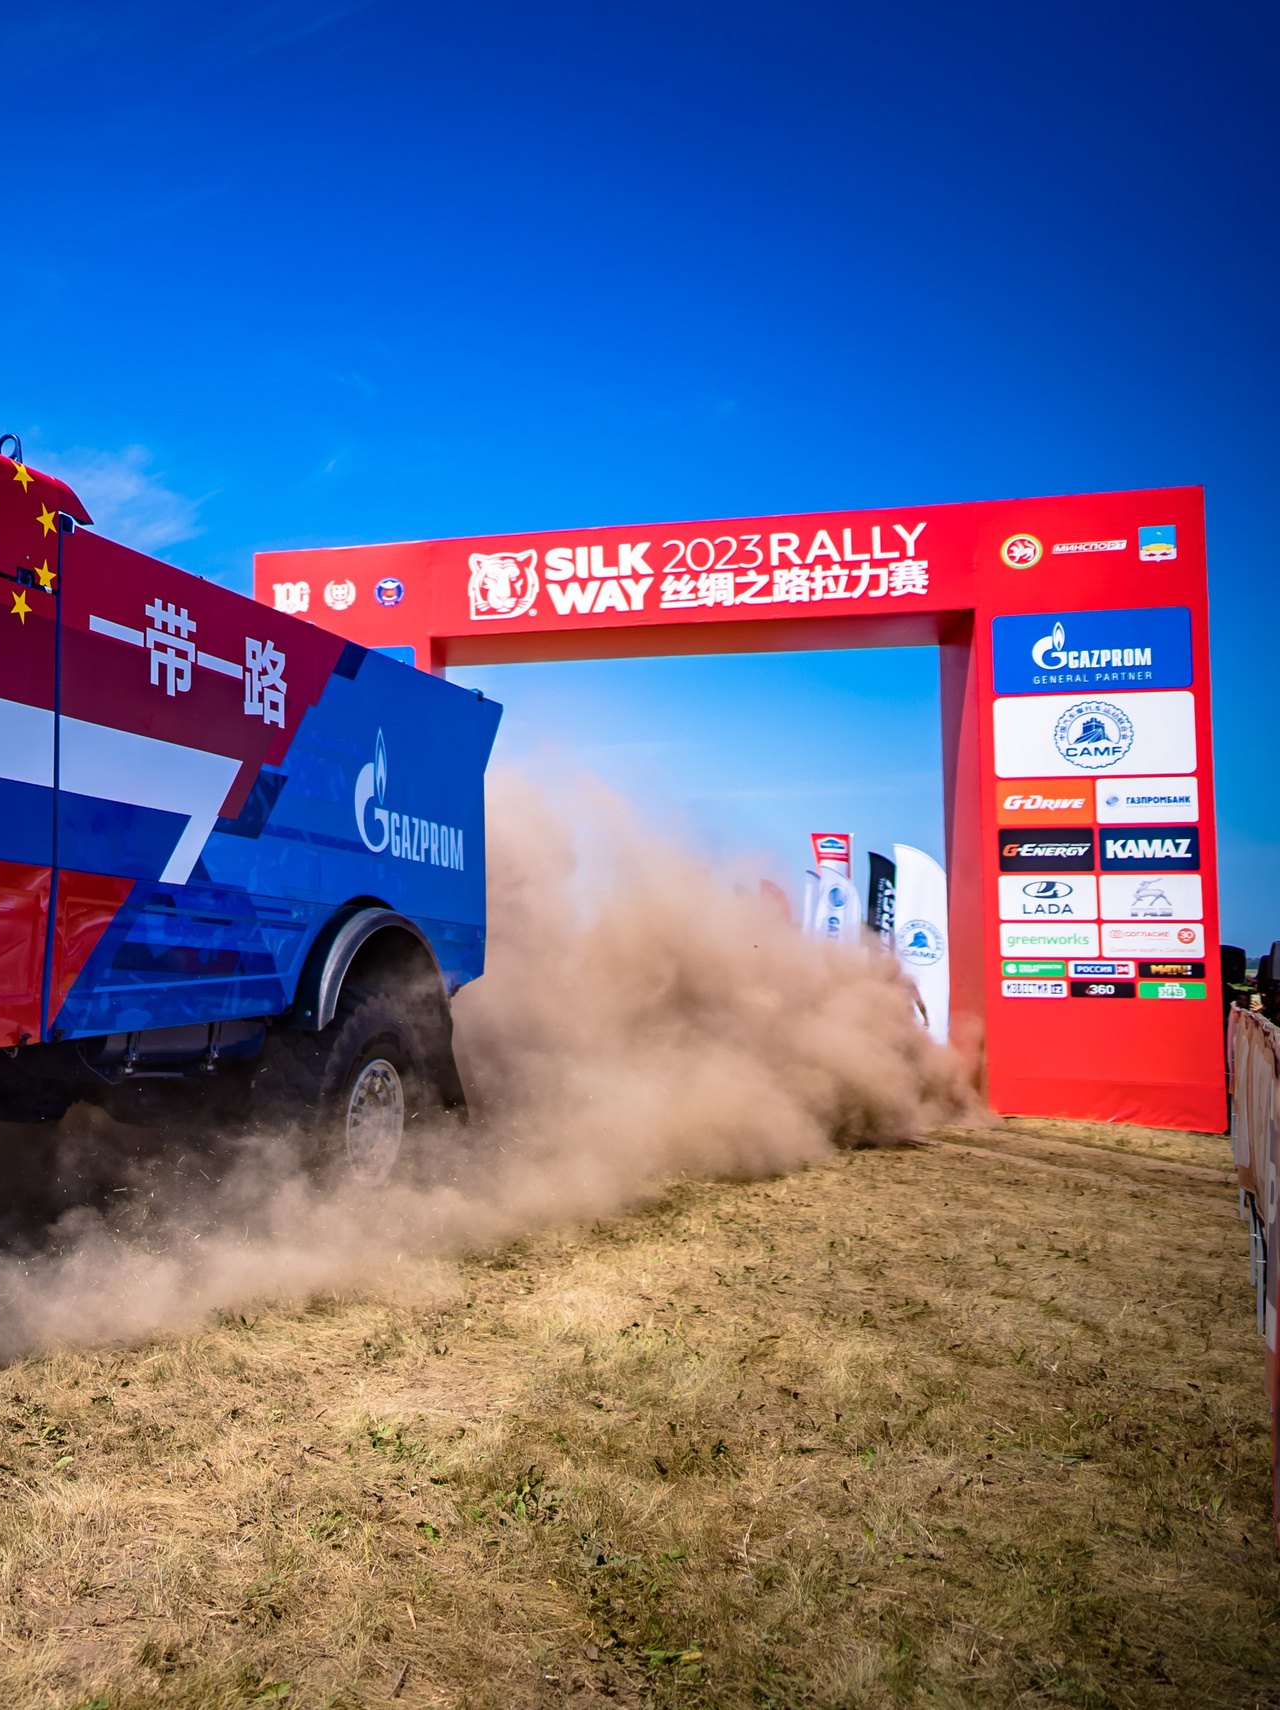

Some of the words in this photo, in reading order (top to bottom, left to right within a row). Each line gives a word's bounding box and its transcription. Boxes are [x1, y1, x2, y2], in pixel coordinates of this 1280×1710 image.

[544, 542, 655, 581] SILK
[662, 535, 763, 574] 2023
[770, 522, 927, 567] RALLY
[1054, 541, 1126, 553] МИНСПОРТ
[660, 560, 929, 609] 丝绸之路拉力赛
[545, 577, 655, 615] WAY
[89, 597, 287, 729] 一带一路
[1069, 648, 1152, 669] GAZPROM
[1033, 673, 1089, 685] GENERAL
[1096, 671, 1152, 682] PARTNER
[1065, 746, 1122, 757] CAMF
[1126, 796, 1191, 804] ГАЗПРОМБАНК
[390, 811, 464, 871] GAZPROM
[1105, 839, 1192, 859] KAMAZ
[1022, 903, 1073, 915] LADA
[1007, 933, 1090, 947] greenworks
[1179, 931, 1194, 939] 30
[1076, 965, 1113, 973] РОССИЯ
[1088, 984, 1115, 995] 360
